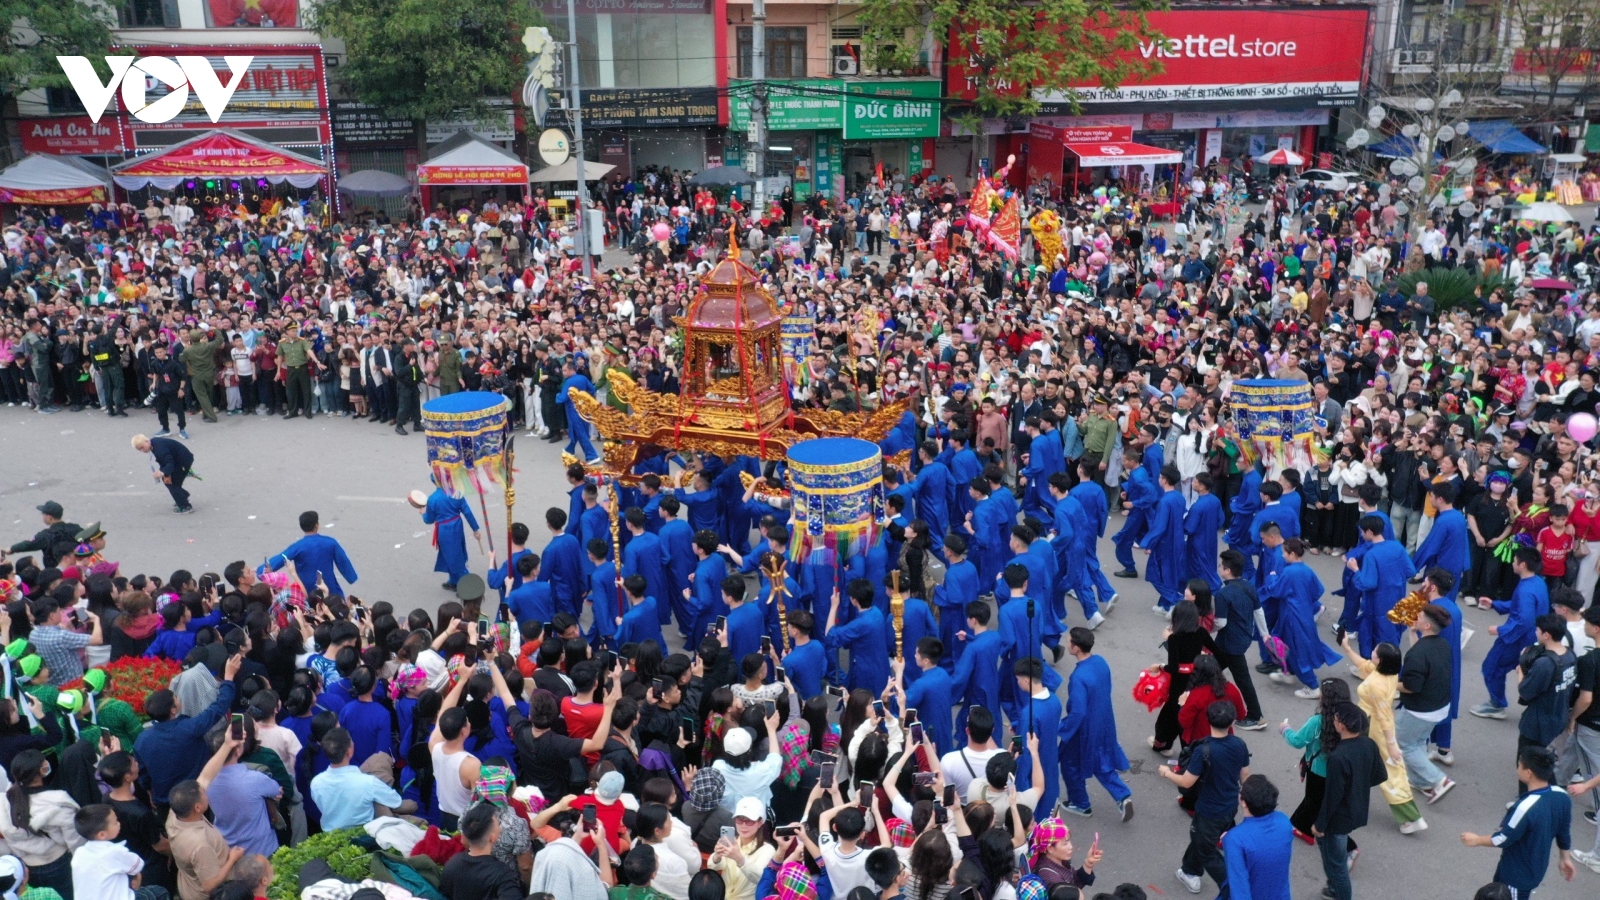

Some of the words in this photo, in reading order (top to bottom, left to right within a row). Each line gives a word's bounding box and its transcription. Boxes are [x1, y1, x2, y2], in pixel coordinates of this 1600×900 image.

[1139, 34, 1238, 58] viettel
[1241, 37, 1296, 57] store
[1236, 88, 1257, 96] MINH
[1262, 86, 1276, 95] SIM
[660, 106, 685, 117] SANG
[687, 105, 717, 119] TRỌNG
[854, 100, 888, 119] ĐỨC
[893, 100, 932, 118] BÌNH
[31, 123, 62, 137] Anh
[66, 123, 88, 137] Cu
